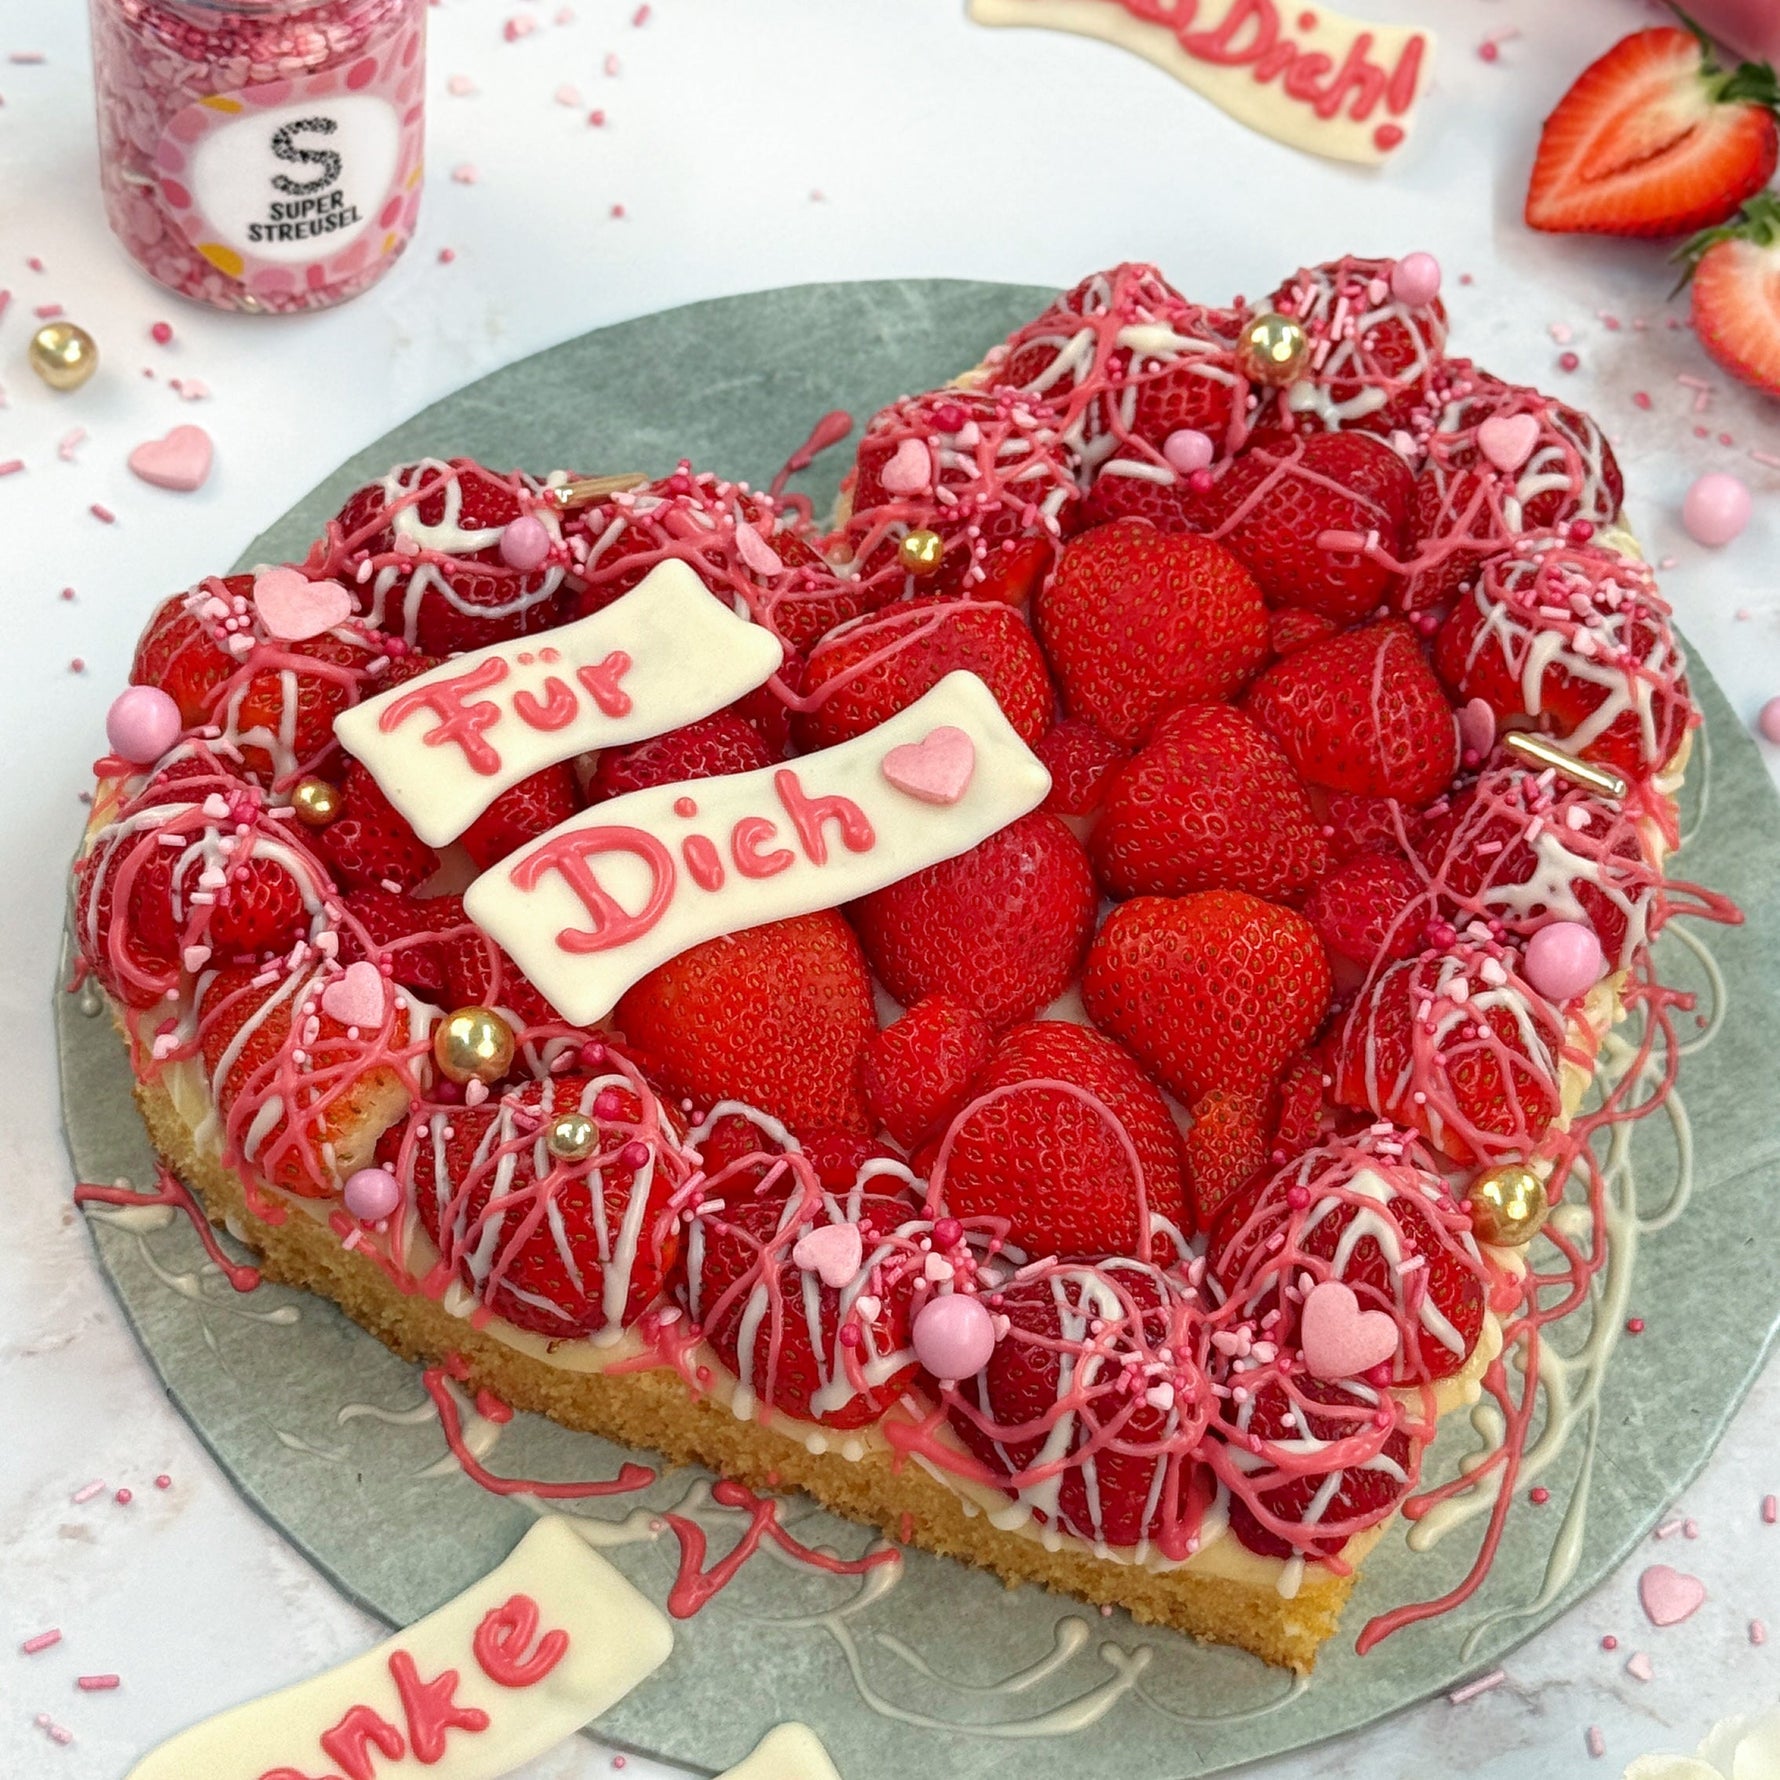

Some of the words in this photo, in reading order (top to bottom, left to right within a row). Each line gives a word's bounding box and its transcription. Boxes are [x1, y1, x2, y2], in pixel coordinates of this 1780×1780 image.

[1180, 0, 1425, 152] Dich!
[248, 206, 364, 243] STREUSEL
[269, 189, 344, 221] SUPER
[379, 647, 633, 777] Für
[510, 769, 877, 954] Dich
[258, 1594, 570, 1780] nke
